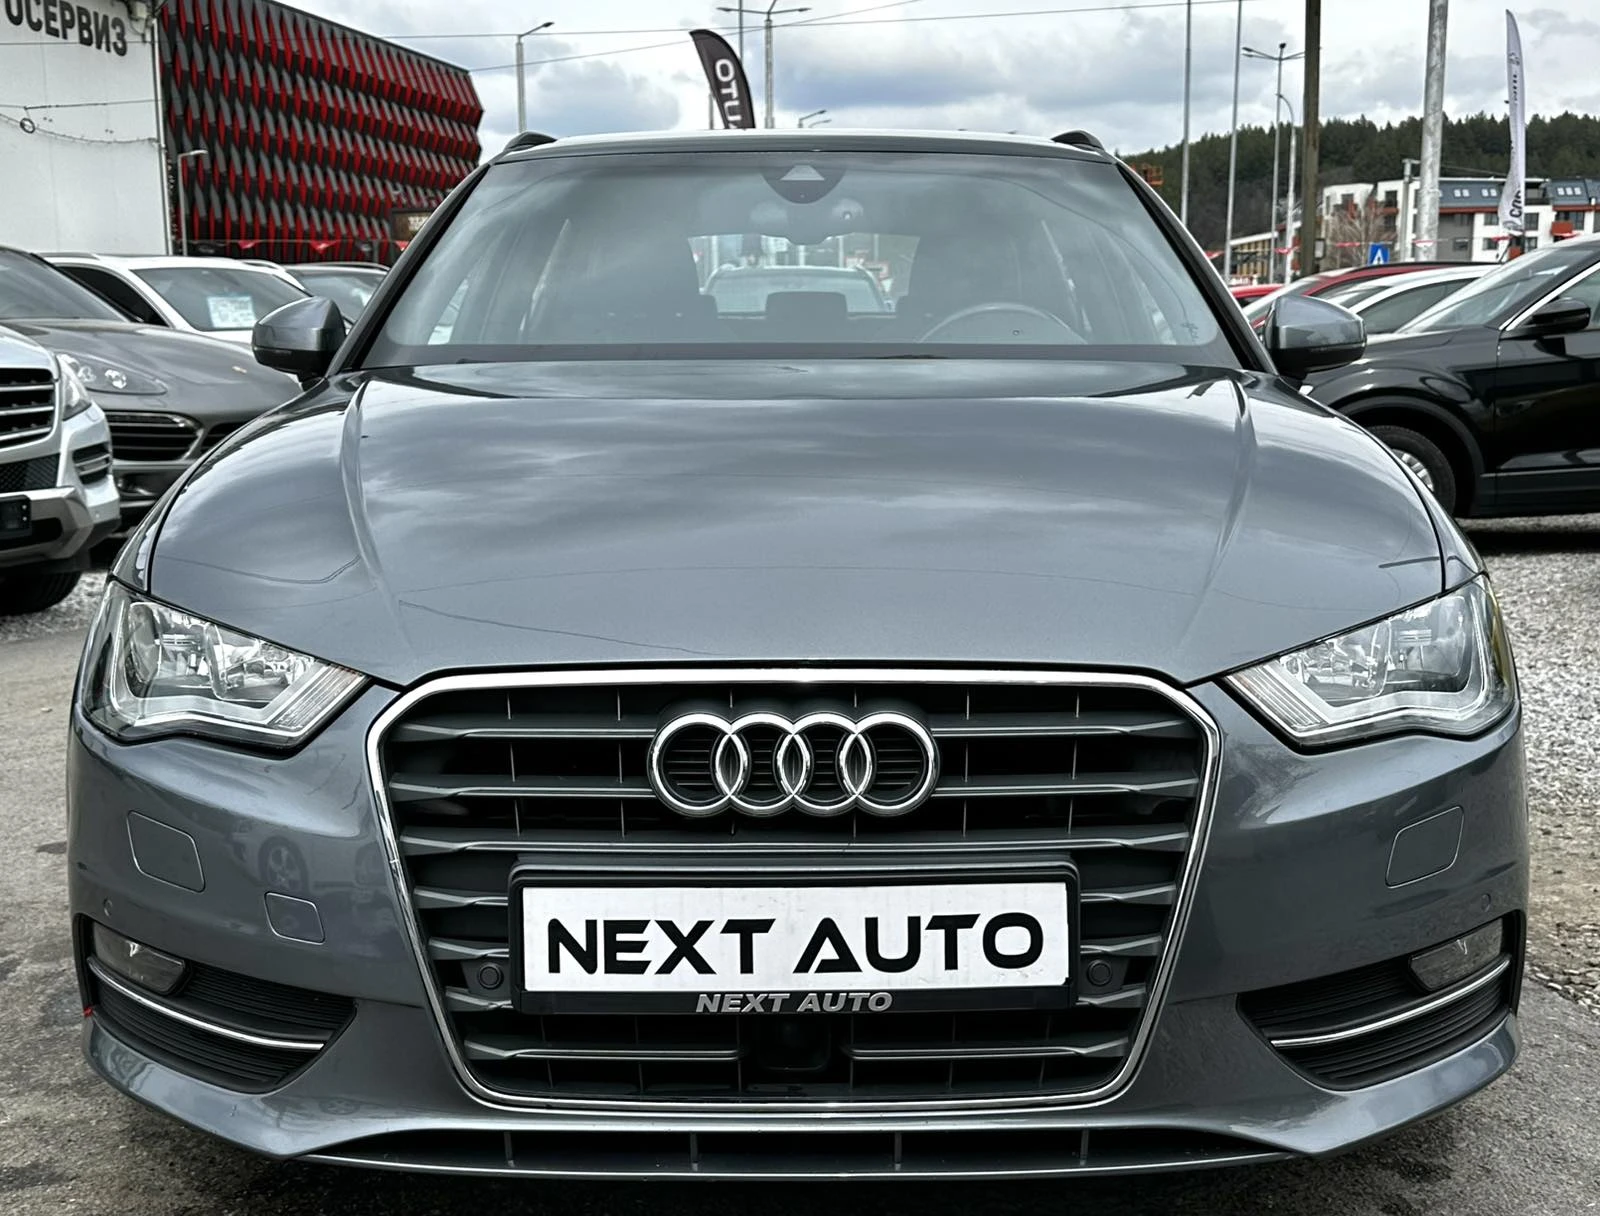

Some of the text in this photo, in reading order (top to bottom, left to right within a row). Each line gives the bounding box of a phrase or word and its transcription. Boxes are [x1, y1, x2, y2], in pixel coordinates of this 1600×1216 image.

[547, 912, 1044, 975] NEXT AUTO
[696, 992, 893, 1013] NEXT AUTO
